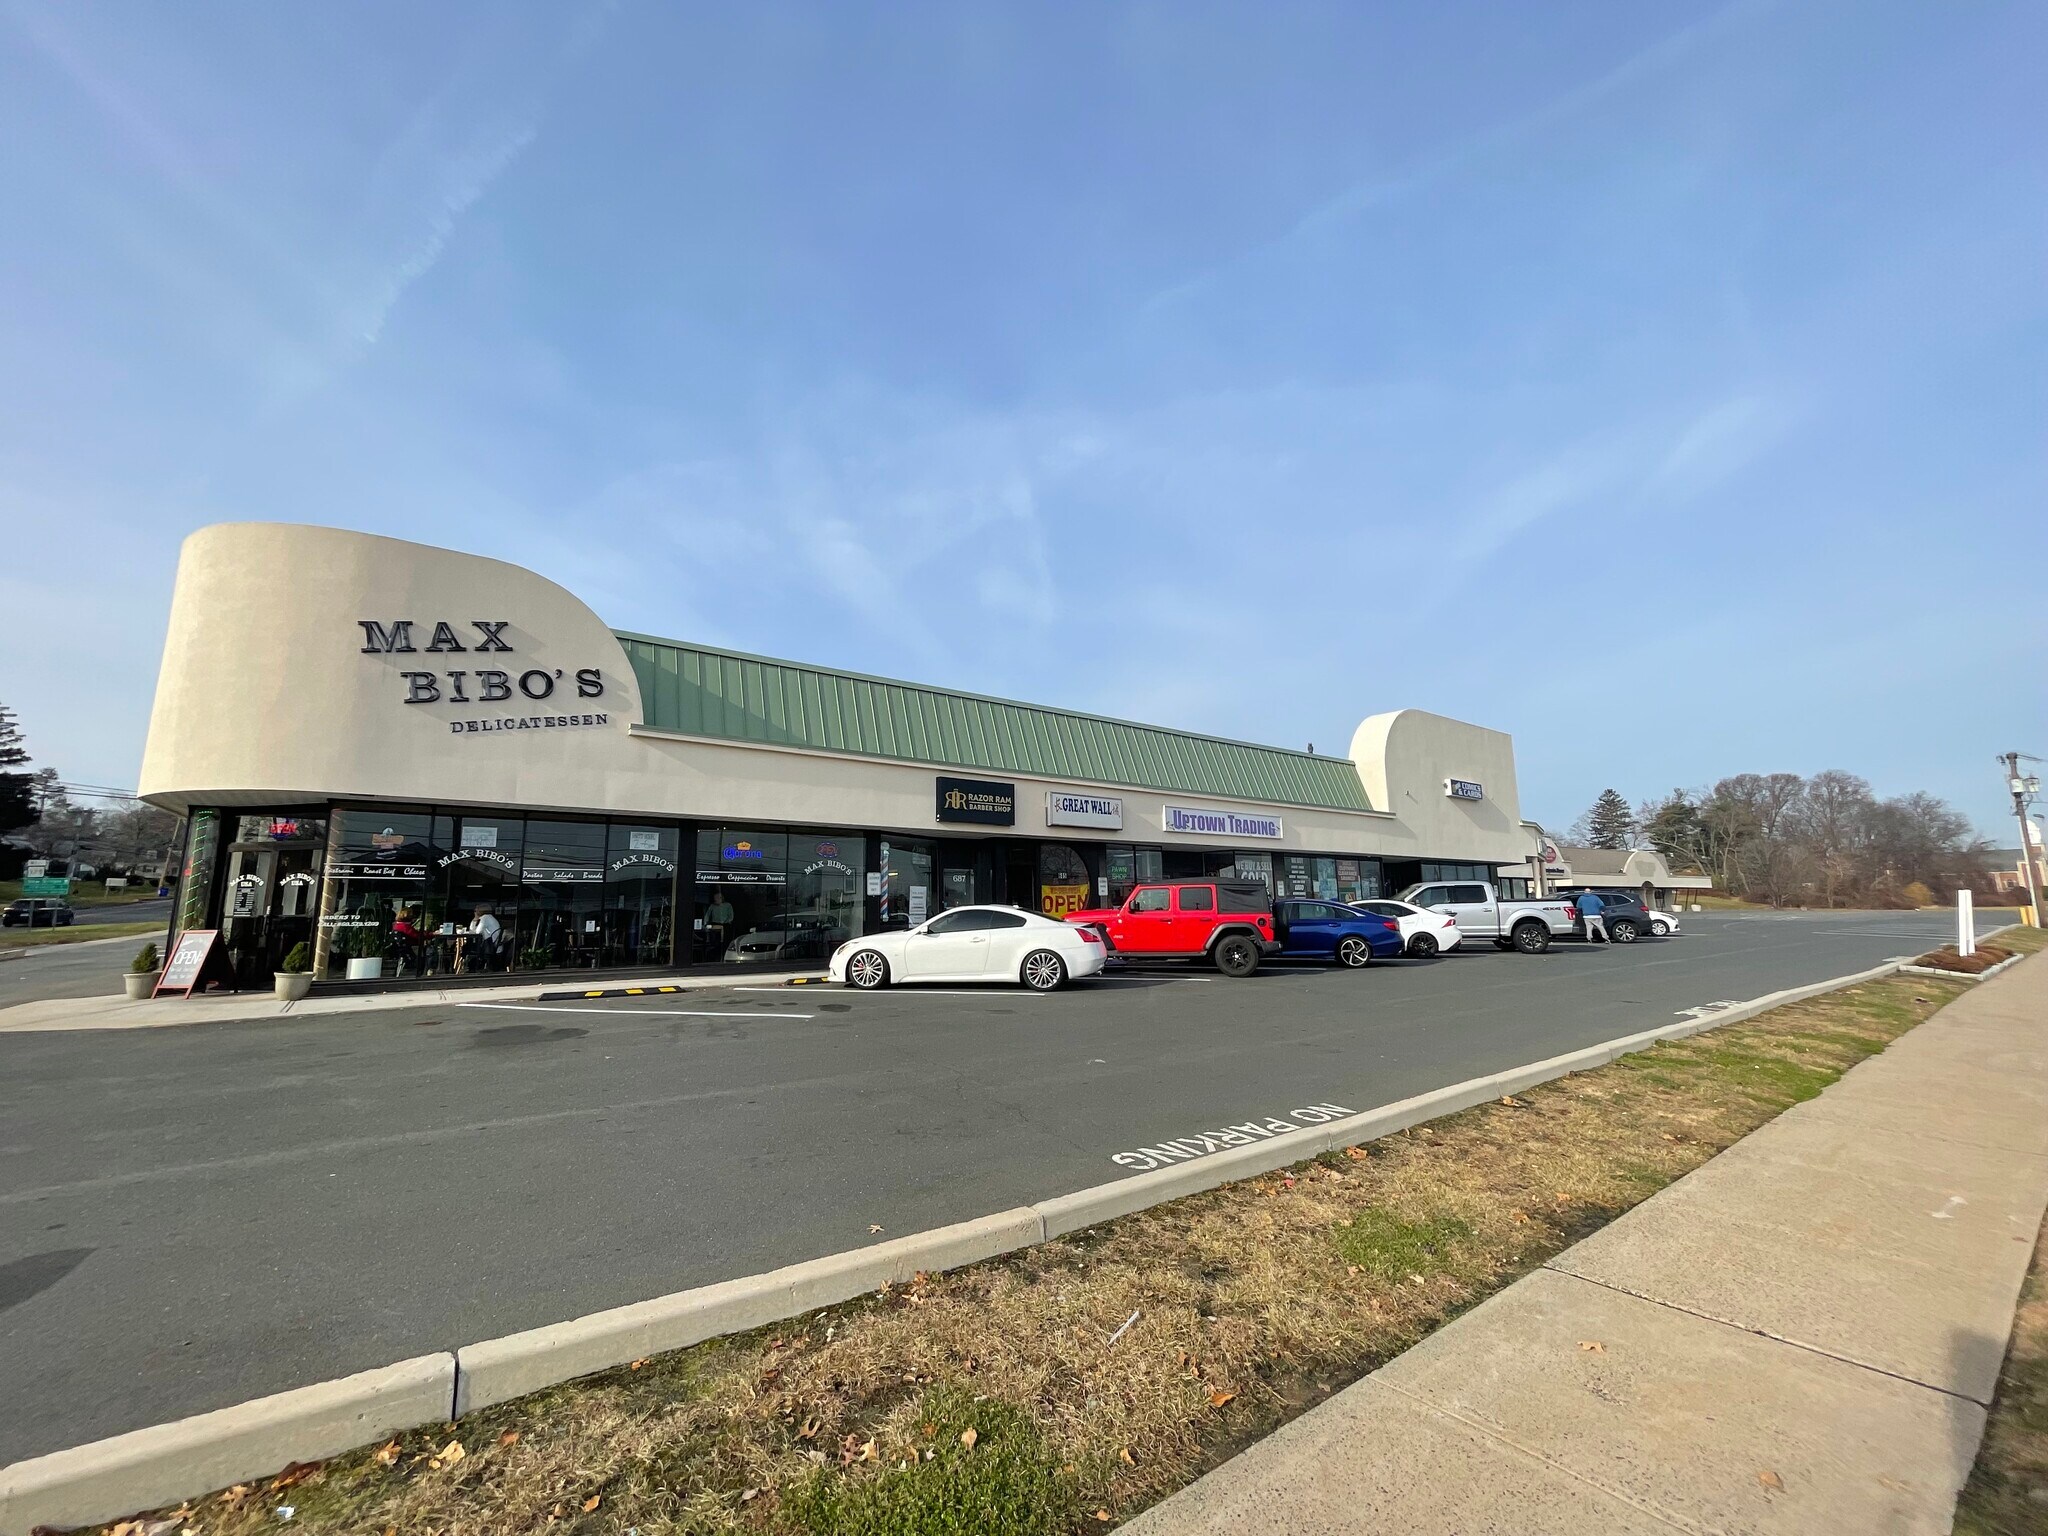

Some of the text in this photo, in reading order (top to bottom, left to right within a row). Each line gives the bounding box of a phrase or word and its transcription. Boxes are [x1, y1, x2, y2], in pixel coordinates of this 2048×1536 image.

[357, 621, 513, 653] MAX
[400, 669, 604, 703] BIBO'S
[450, 714, 608, 734] DELICATESSEN
[968, 793, 1012, 804] RAZOR RAM
[1062, 797, 1089, 813] GREAT
[1090, 800, 1113, 815] WALL
[969, 804, 993, 812] BARBER
[1173, 810, 1276, 836] UPTOWN TRADING
[437, 849, 515, 869] MAX BIBO'S
[723, 846, 763, 860] Corona
[611, 854, 674, 872] MAX BIBO'S
[804, 860, 852, 876] MAX BIBO'S
[229, 875, 245, 887] MAX
[279, 874, 296, 887] MAX
[952, 874, 966, 882] 687
[1042, 895, 1087, 913] OPEN
[1111, 1102, 1358, 1170] NO PARKING
